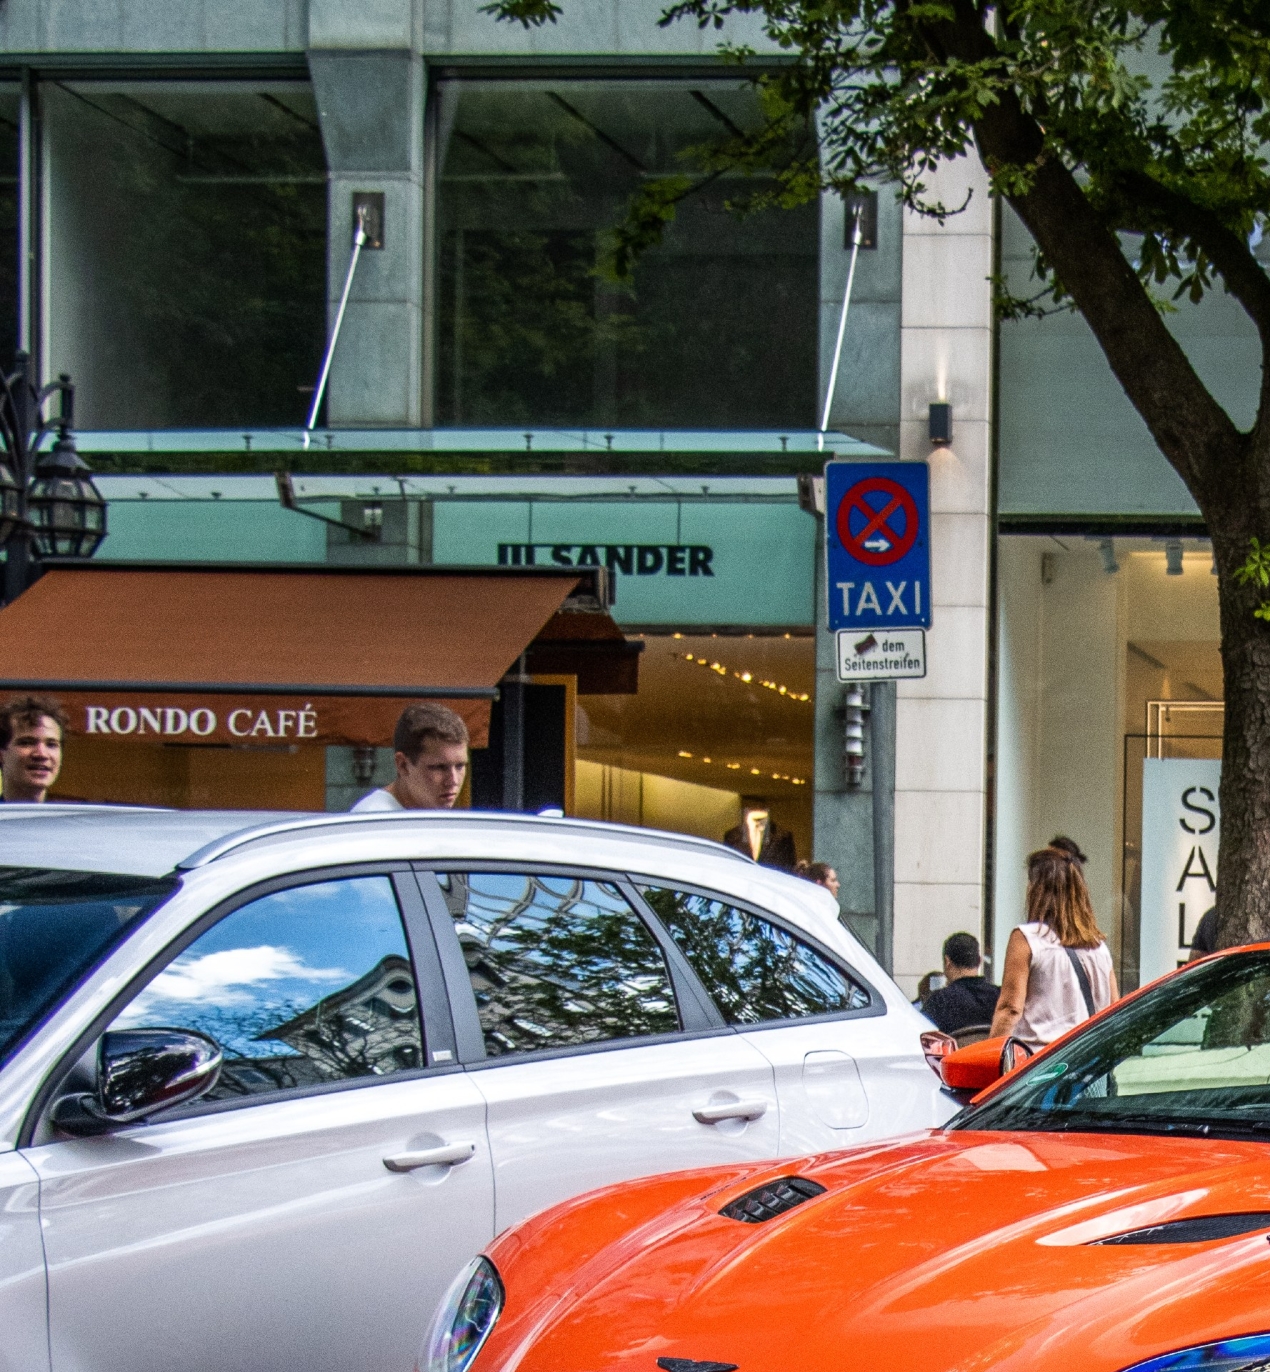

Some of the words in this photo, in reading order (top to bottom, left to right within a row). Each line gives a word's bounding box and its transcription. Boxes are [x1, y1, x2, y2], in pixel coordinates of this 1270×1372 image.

[551, 544, 715, 577] SANDER
[836, 580, 921, 616] TAXI
[844, 652, 920, 671] Seitenstreifen
[882, 639, 905, 652] dem
[86, 706, 217, 735] RONDO
[227, 703, 317, 737] CAFÉ
